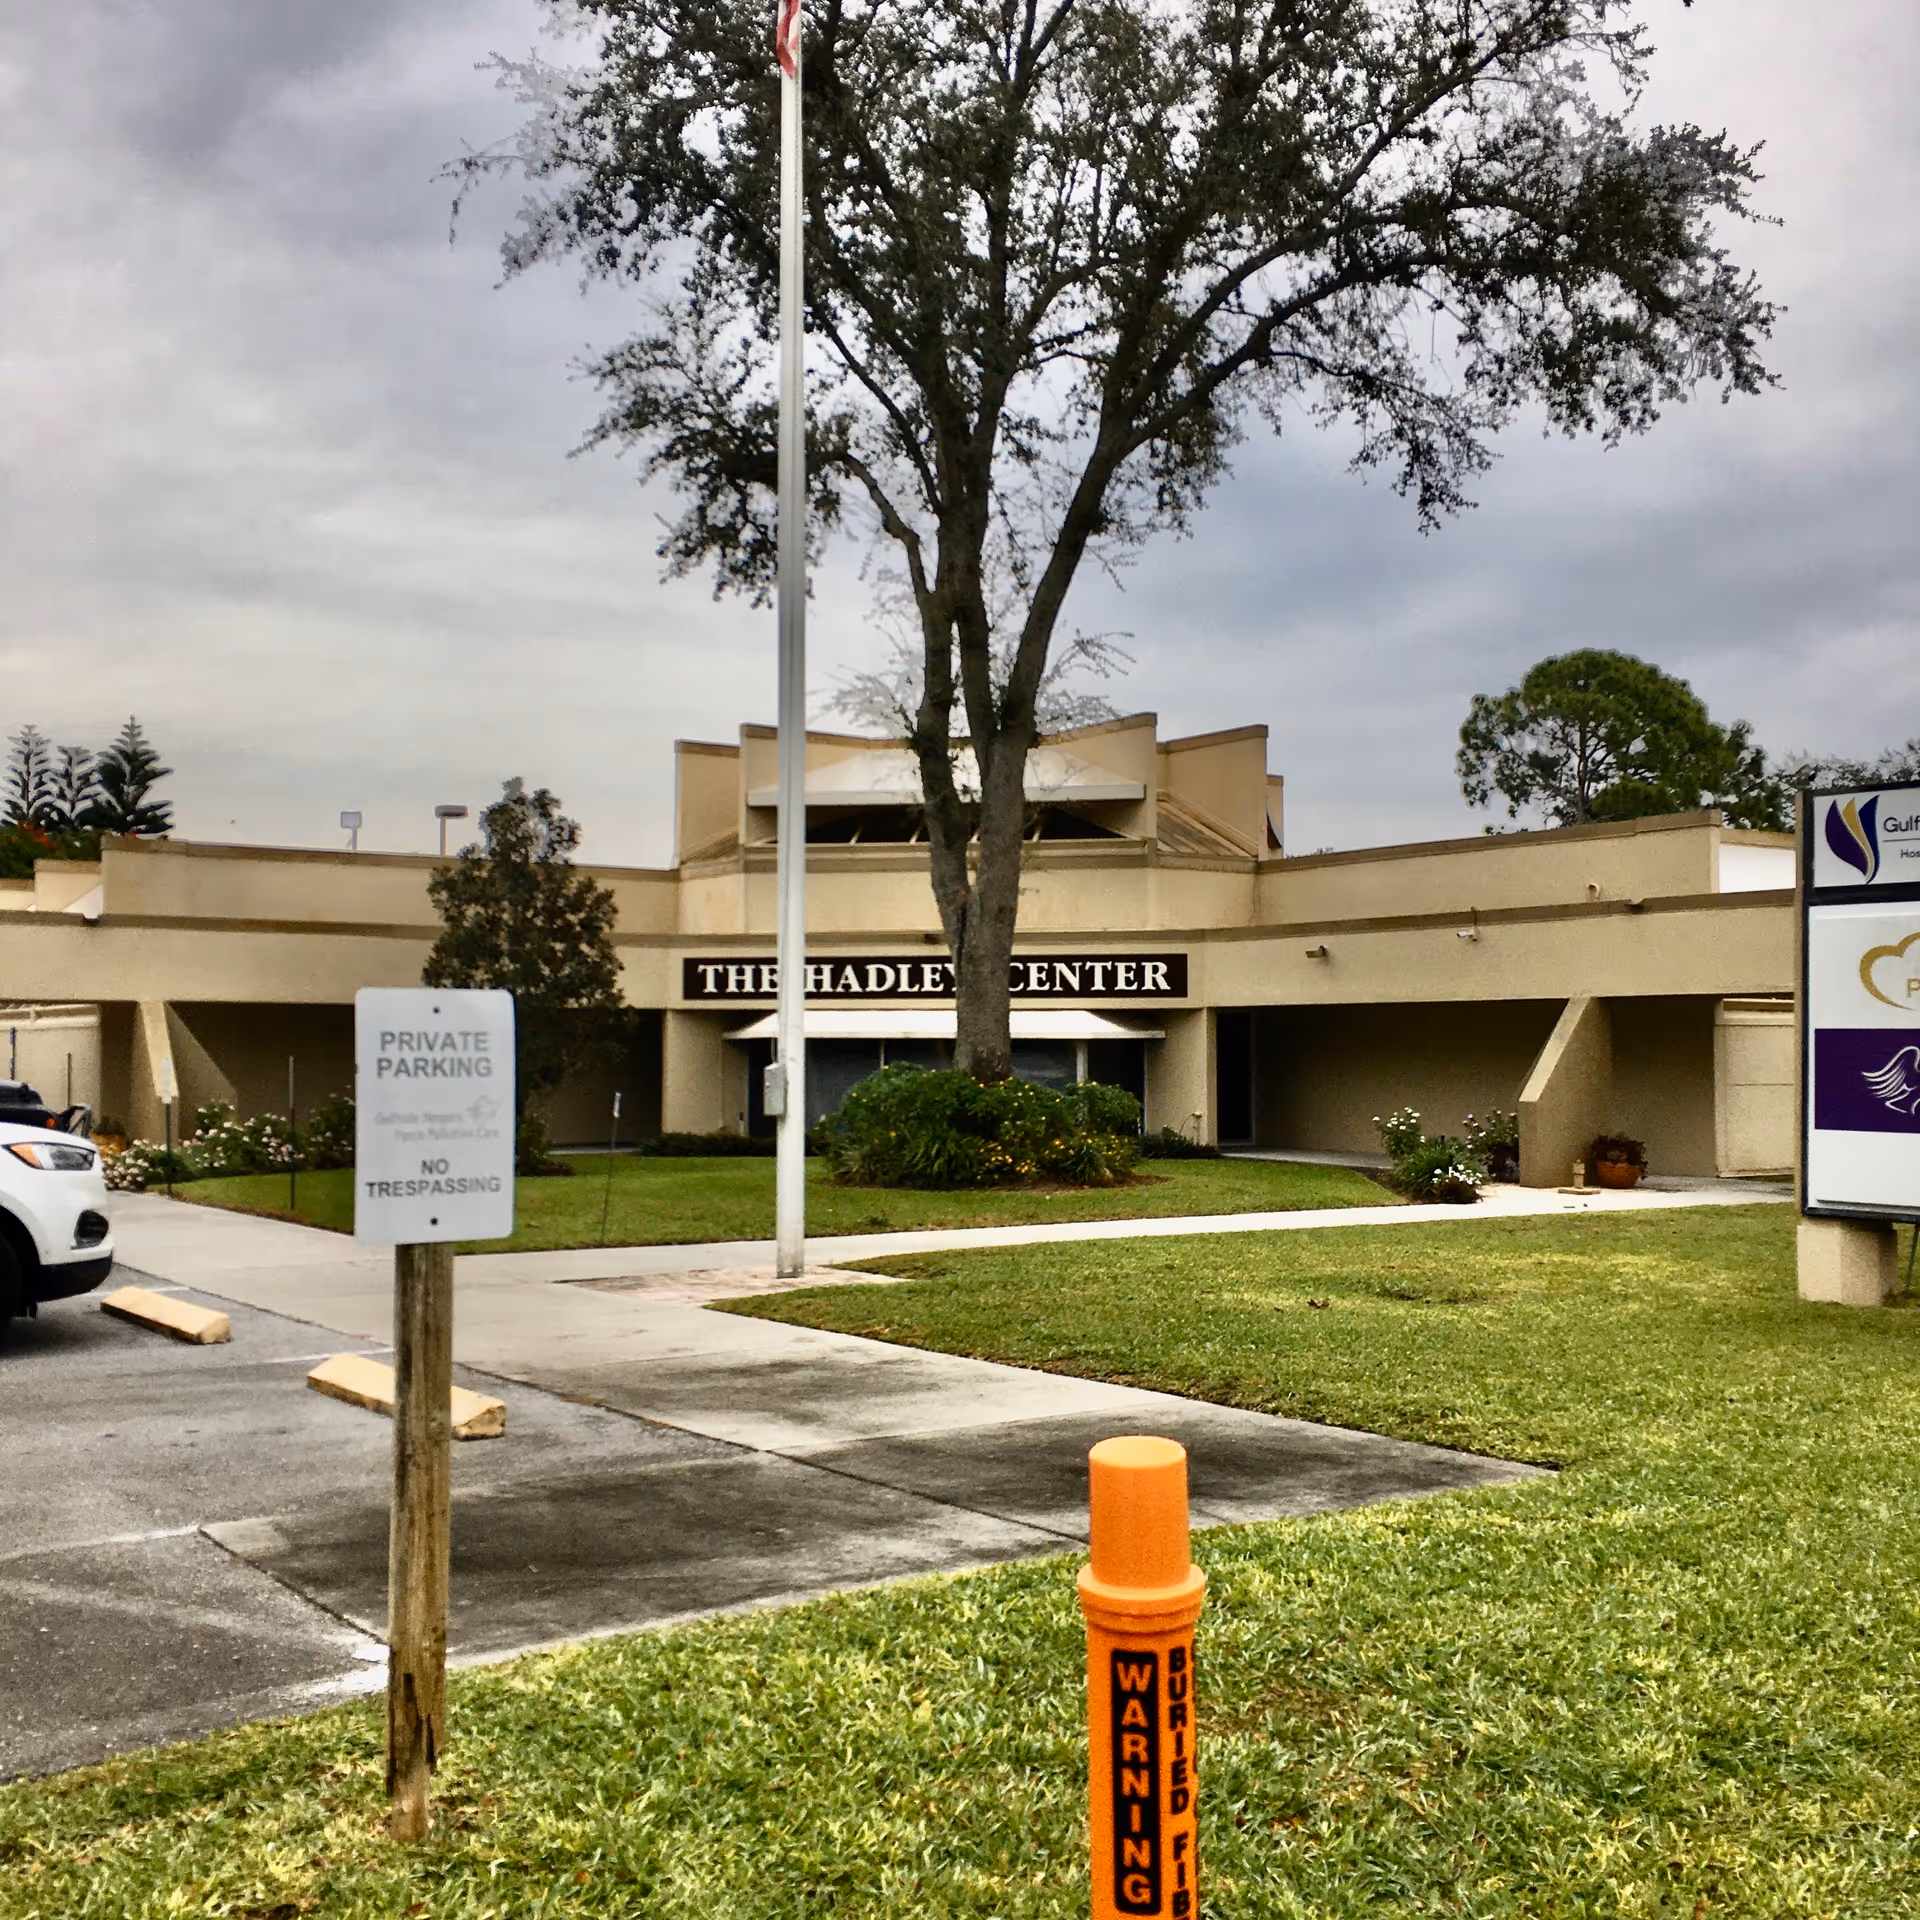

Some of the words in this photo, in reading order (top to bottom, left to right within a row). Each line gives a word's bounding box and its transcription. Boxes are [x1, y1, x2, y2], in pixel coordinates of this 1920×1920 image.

[697, 963, 779, 993] THE
[380, 1031, 490, 1053] PRIVATE
[376, 1056, 493, 1080] PARKING
[421, 1158, 450, 1175] NO
[365, 1176, 502, 1199] TRESPASSING
[1168, 1647, 1190, 1815] BURIED
[1116, 1661, 1152, 1904] WARNING
[1172, 1831, 1191, 1920] FIB
